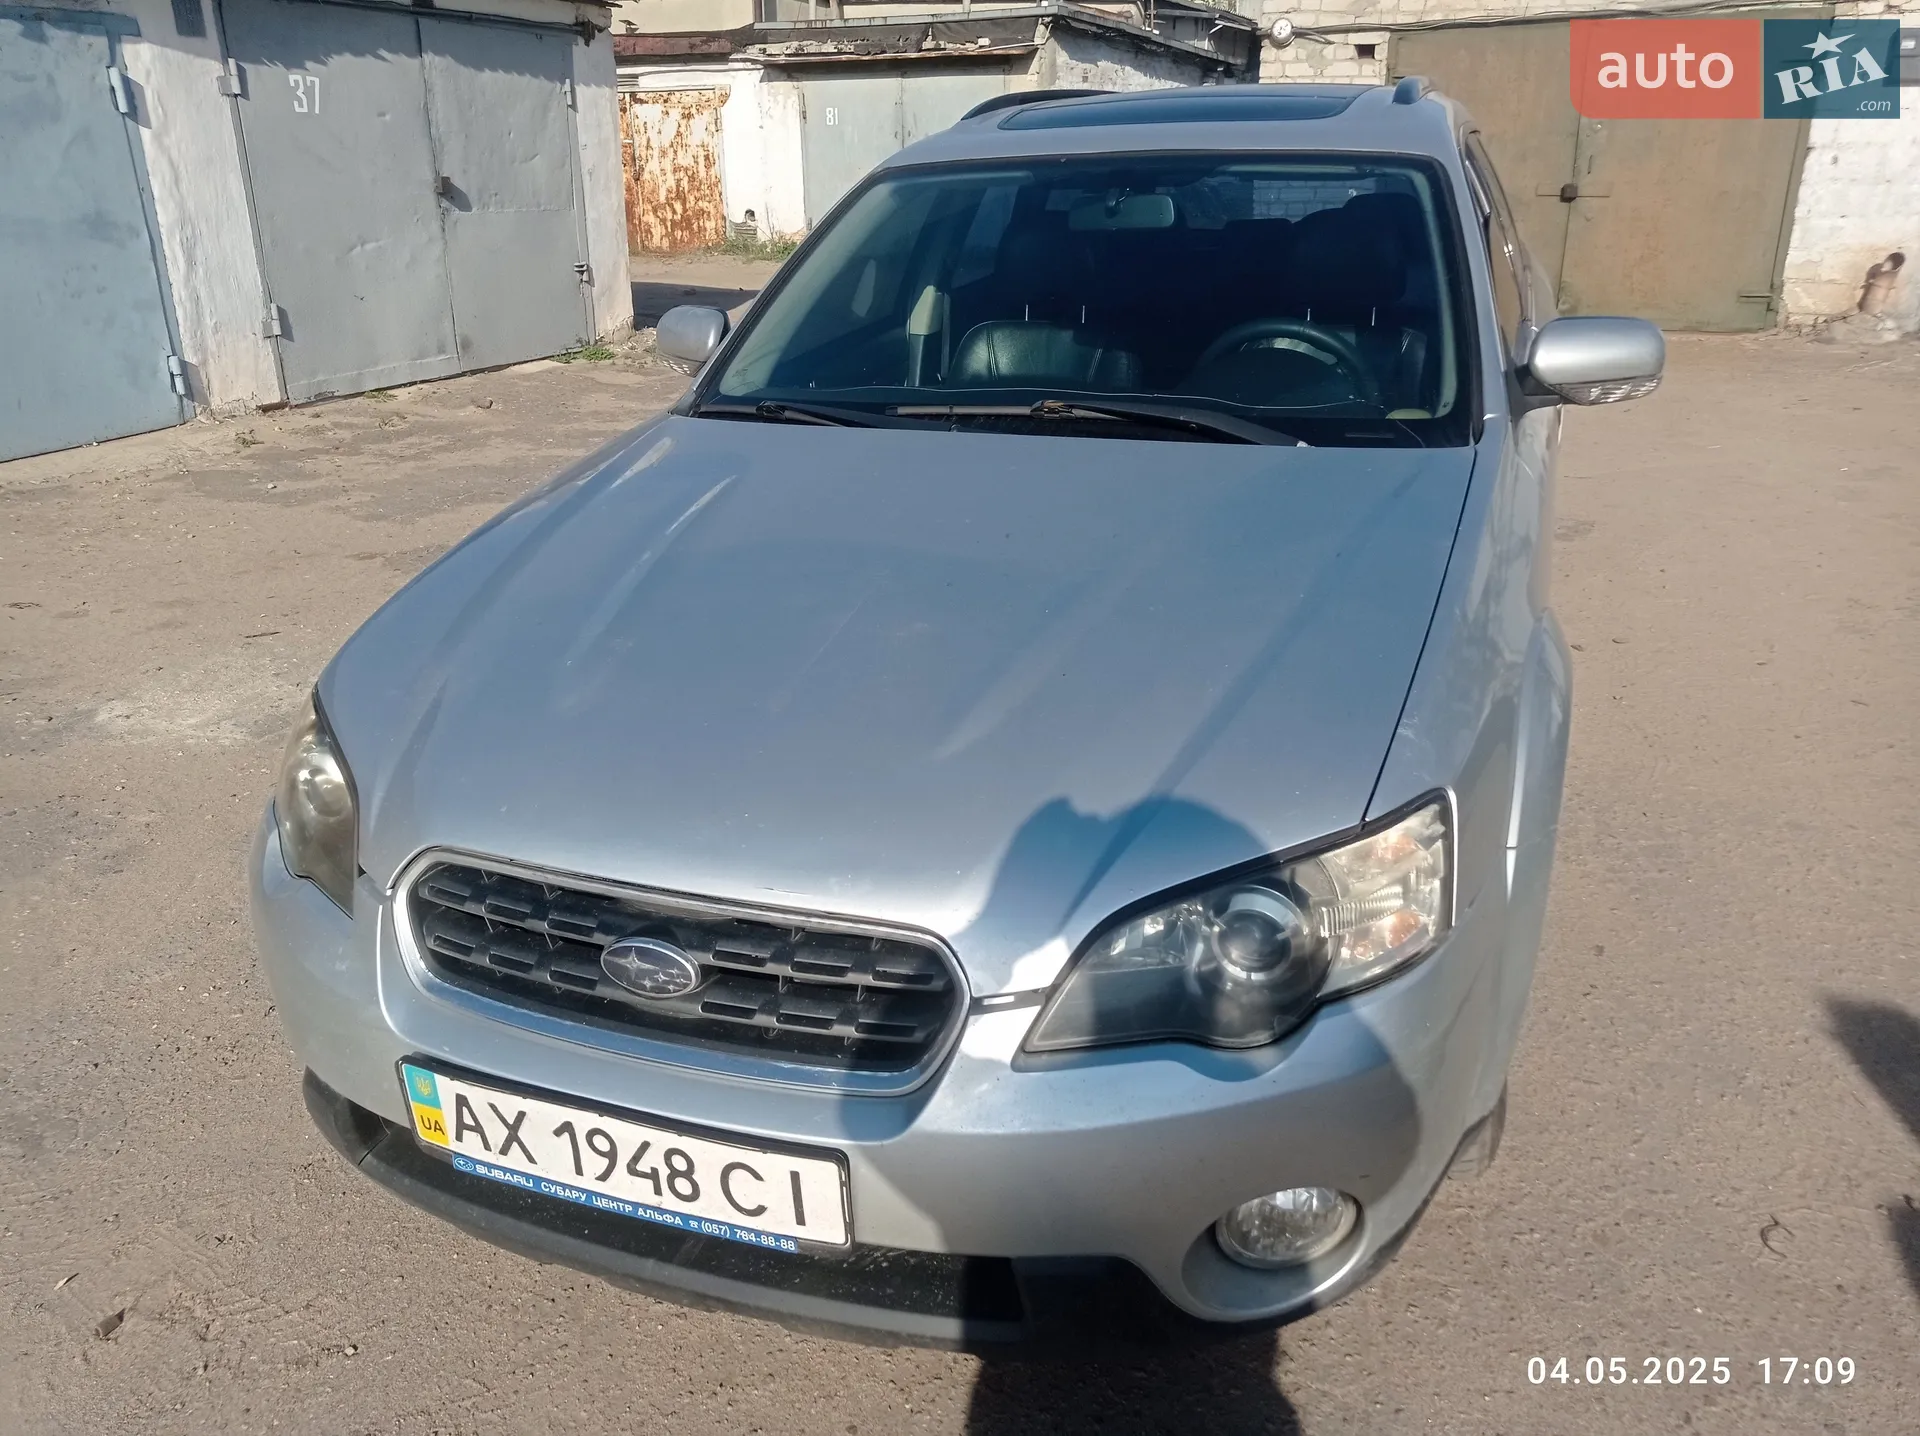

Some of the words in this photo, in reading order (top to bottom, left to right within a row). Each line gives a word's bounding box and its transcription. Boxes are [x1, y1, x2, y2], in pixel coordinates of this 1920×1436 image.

[288, 74, 320, 114] 37
[826, 107, 838, 126] 81
[420, 1115, 445, 1136] UA
[455, 1092, 538, 1165] AX
[552, 1120, 701, 1203] 1948
[720, 1161, 806, 1226] CI
[475, 1163, 534, 1187] SUBARU
[540, 1181, 587, 1202] СУБАРУ
[591, 1195, 633, 1213] ЦЕНТР
[637, 1209, 684, 1226] АЛЬФА
[701, 1220, 731, 1239] (057)
